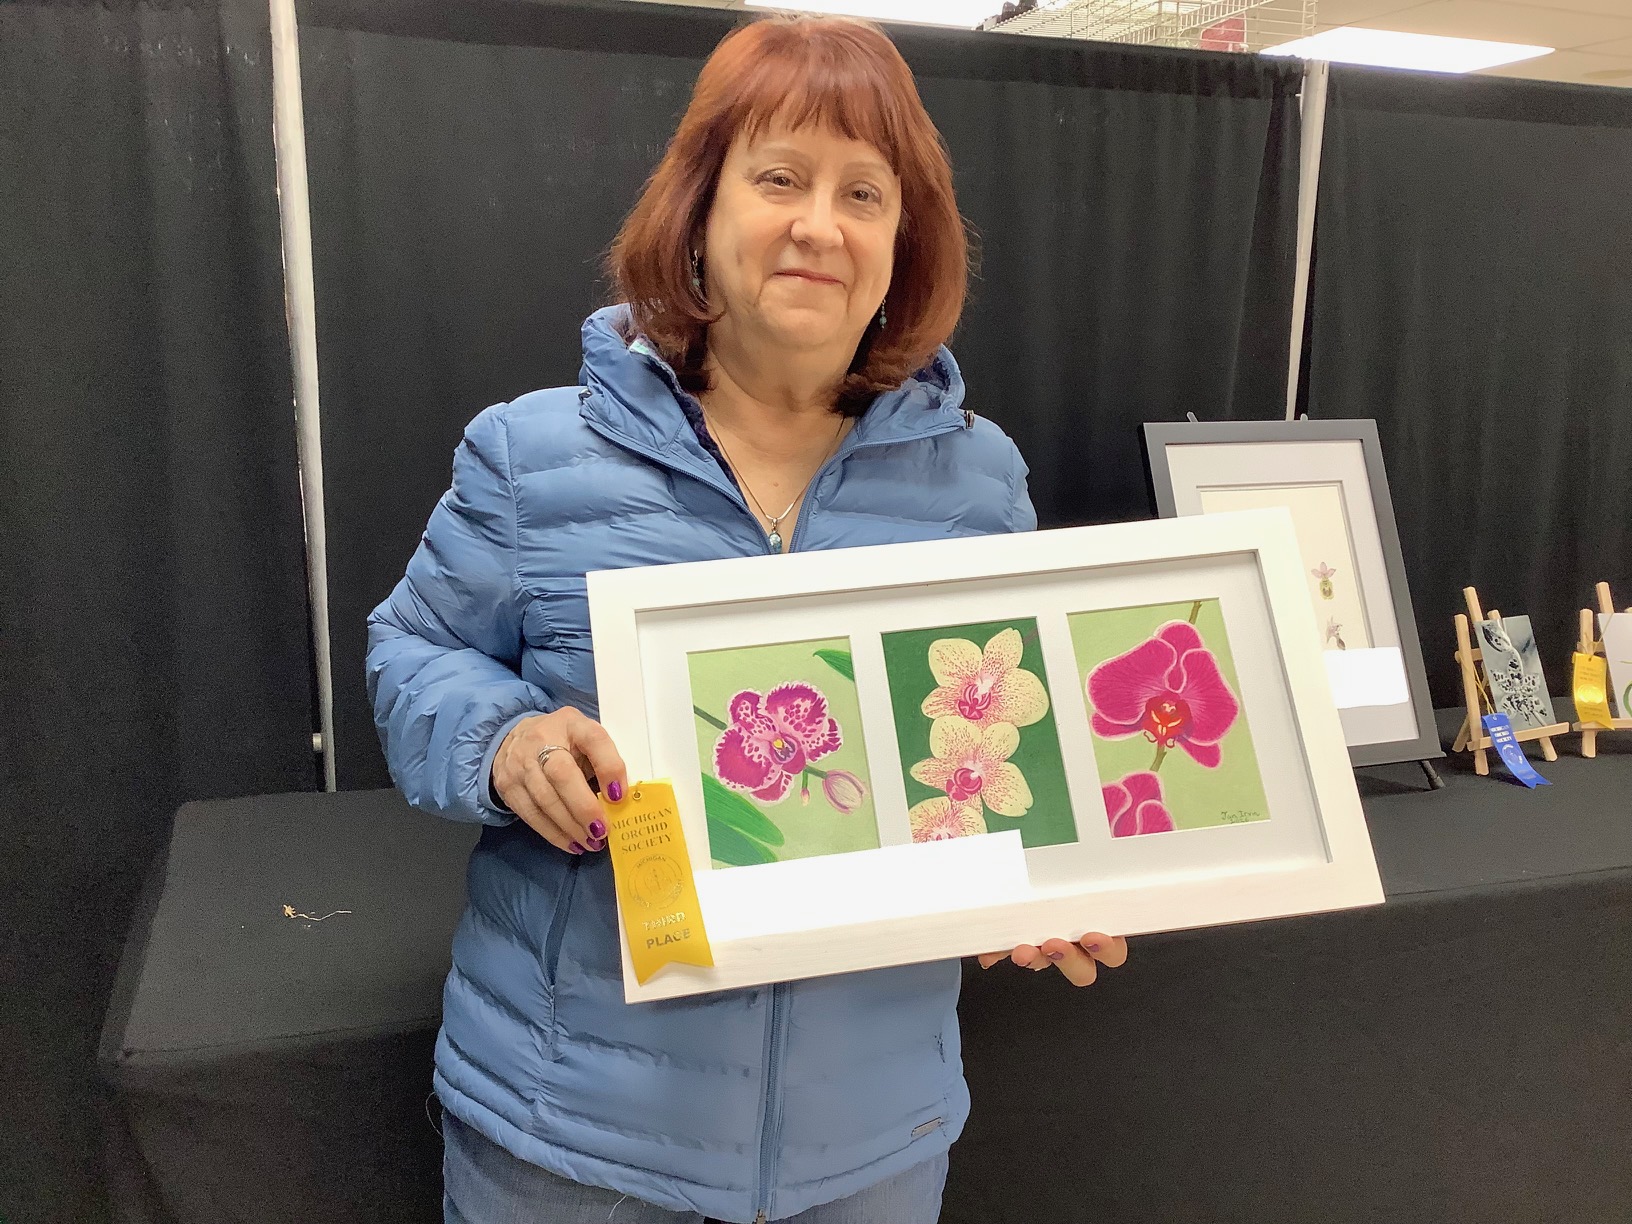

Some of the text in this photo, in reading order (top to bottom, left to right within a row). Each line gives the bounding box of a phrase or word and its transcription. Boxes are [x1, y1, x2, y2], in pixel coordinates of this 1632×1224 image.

[611, 807, 672, 830] MICHIGAN
[621, 822, 668, 841] ORCHID
[622, 833, 672, 854] SOCIETY
[641, 911, 687, 931] THIRD
[646, 928, 691, 949] PLACE
